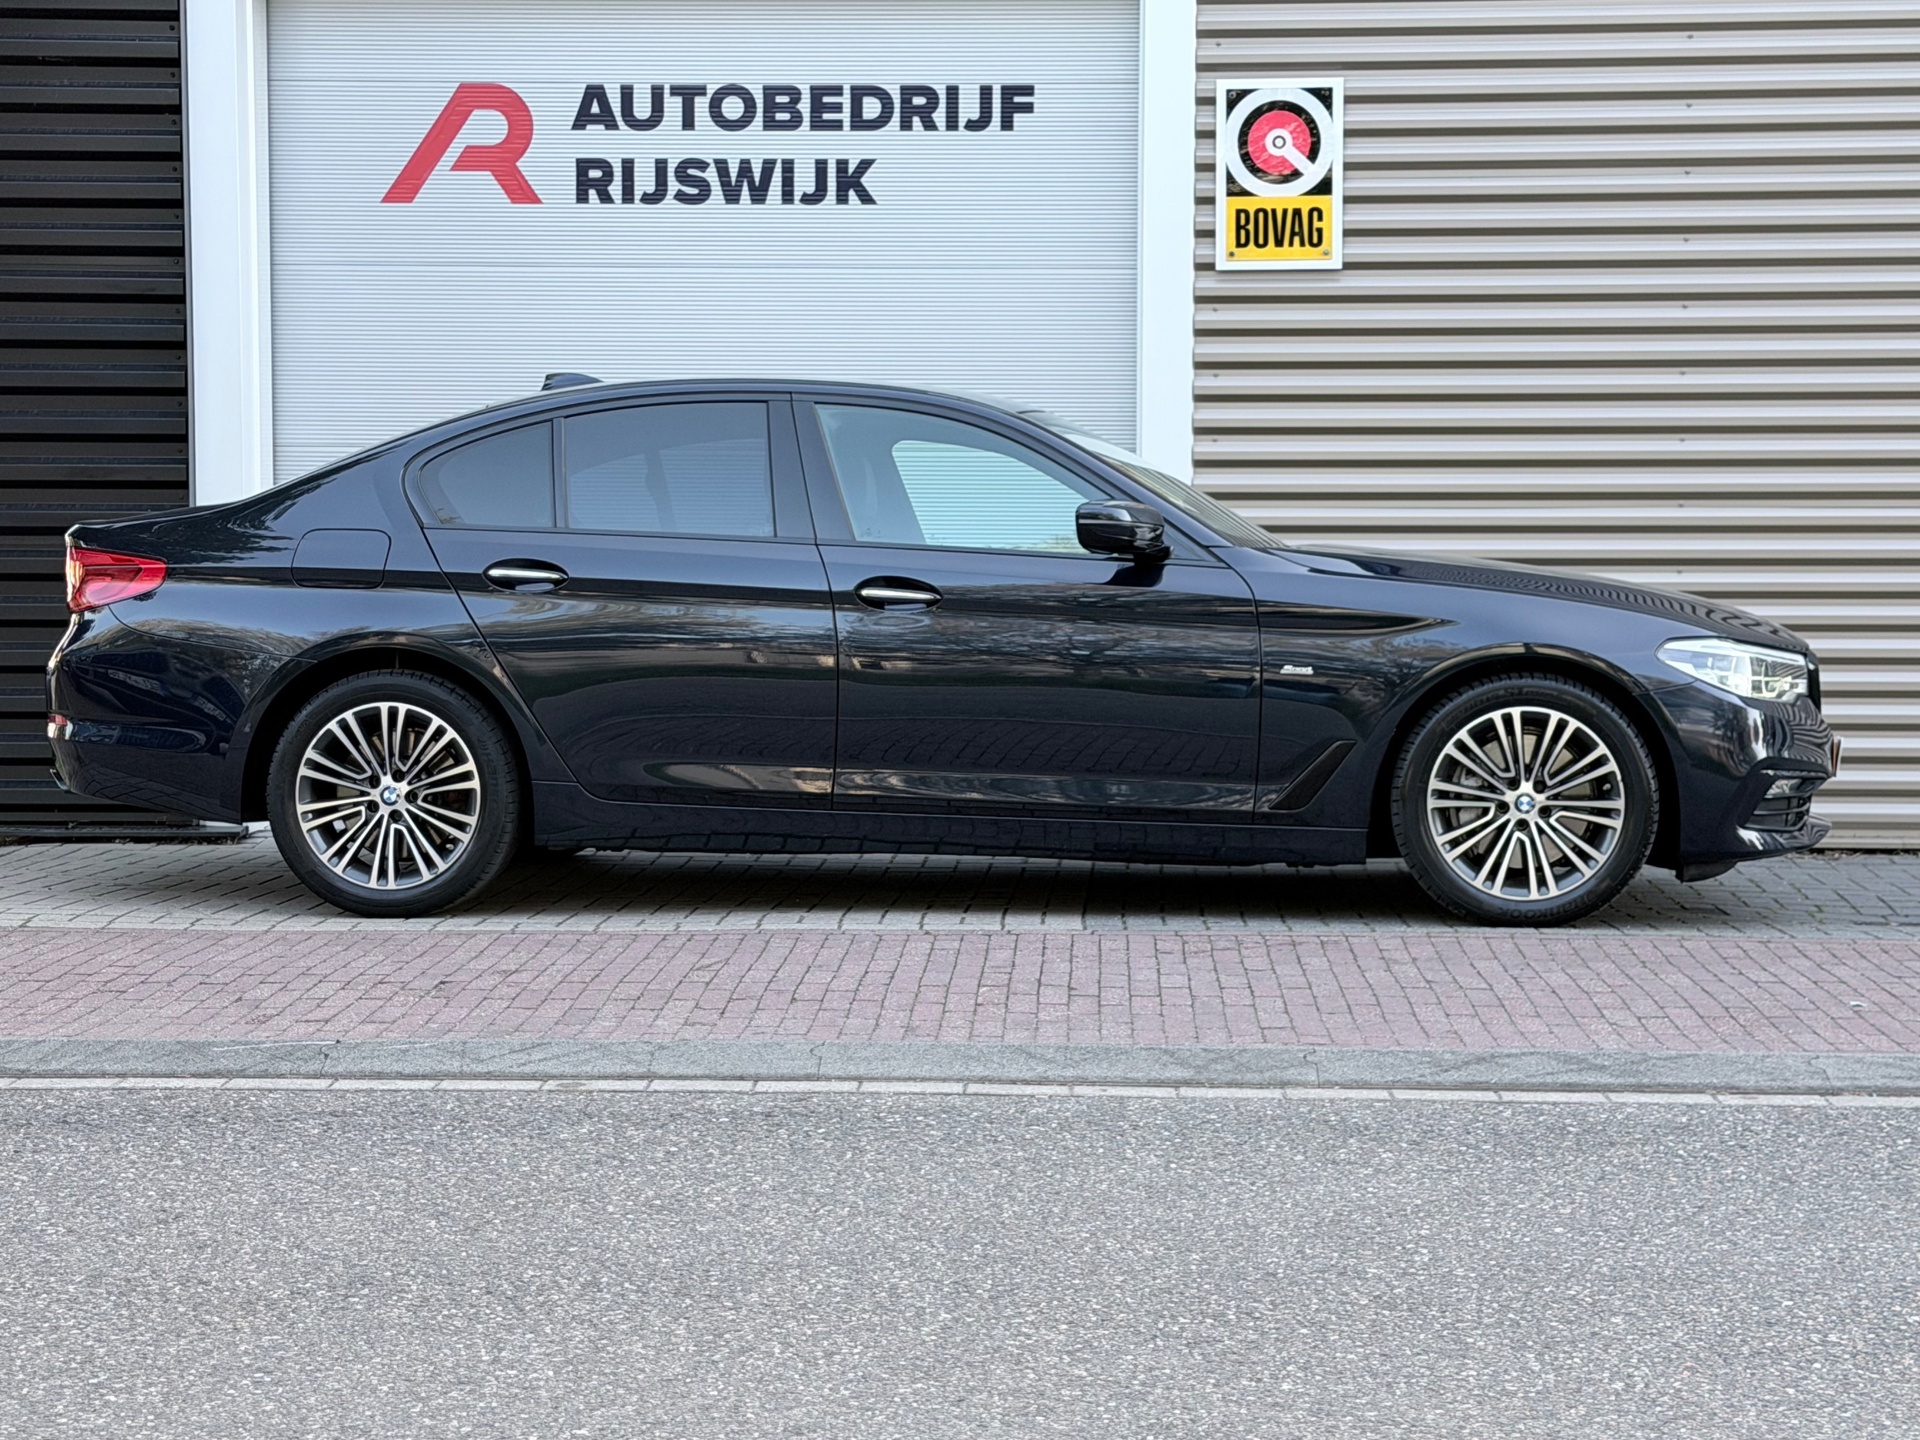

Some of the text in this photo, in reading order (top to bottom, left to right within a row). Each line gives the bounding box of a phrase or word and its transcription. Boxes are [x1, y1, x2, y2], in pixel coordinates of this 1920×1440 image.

[572, 84, 1035, 132] AUTOBEDRIJF
[576, 158, 876, 206] RIJSWIJK
[1235, 206, 1324, 249] BOVAG
